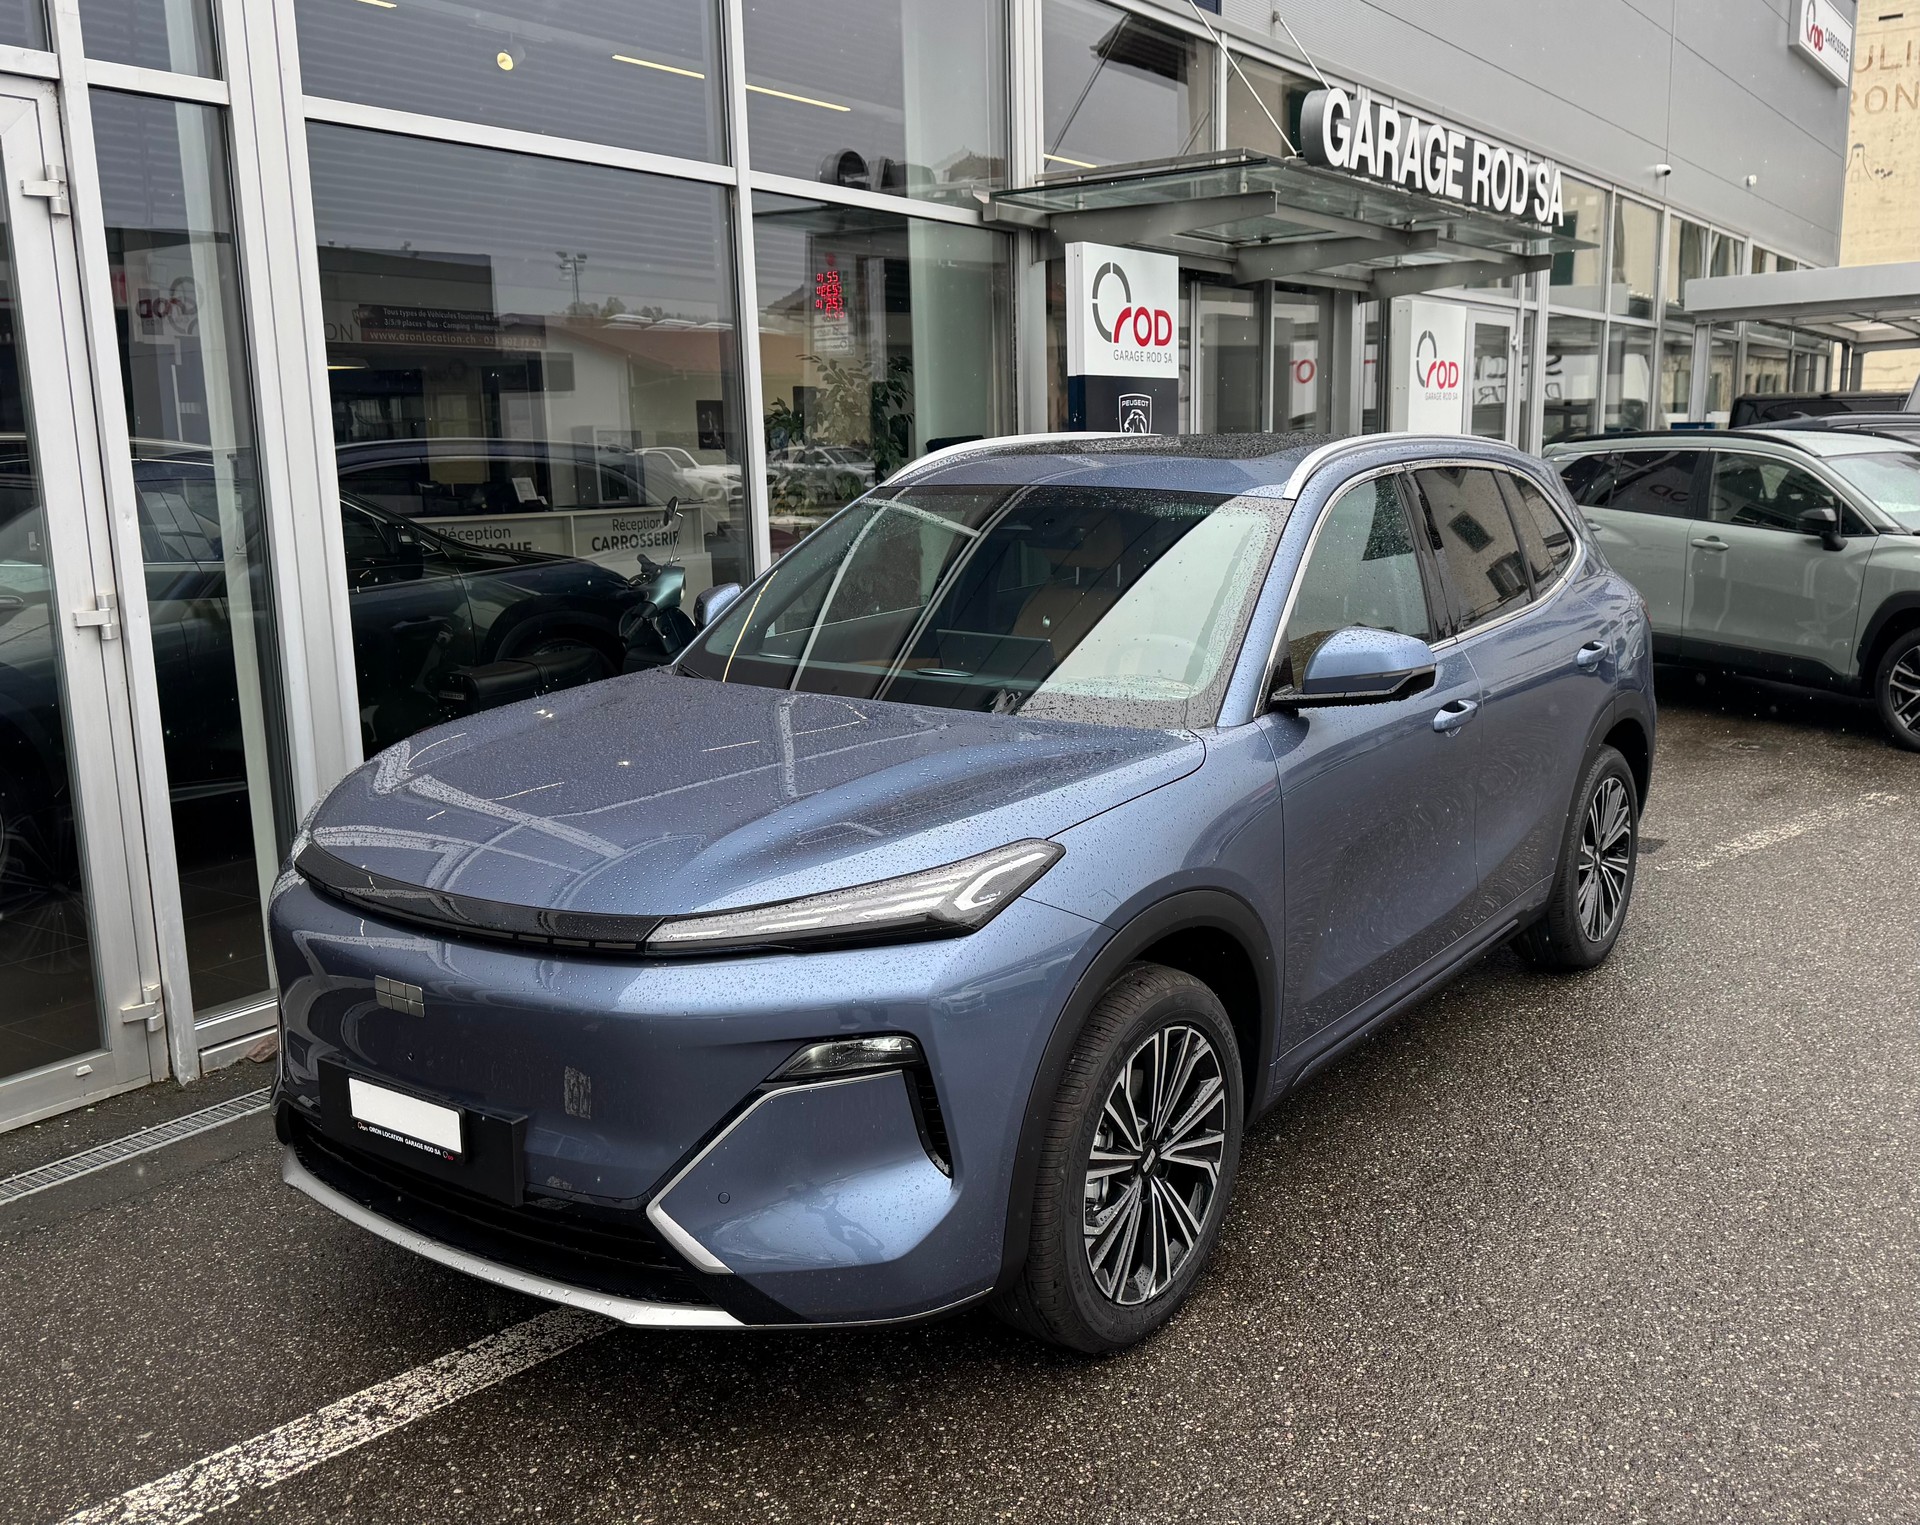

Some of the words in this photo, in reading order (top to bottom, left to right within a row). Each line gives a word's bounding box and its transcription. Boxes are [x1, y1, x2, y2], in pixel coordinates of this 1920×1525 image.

[1825, 28, 1849, 63] CARROSSERIE
[1322, 88, 1466, 199] GARAGE
[1471, 140, 1529, 216] ROD
[1534, 162, 1564, 227] SA
[384, 308, 399, 316] Tous
[400, 309, 417, 318] types
[457, 312, 485, 321] Tourisme
[402, 319, 422, 328] places
[427, 320, 439, 328] Bus
[442, 321, 471, 332] Camping
[369, 331, 476, 345] www.oronlocation.ch
[1113, 349, 1144, 362] GARAGE
[1146, 351, 1162, 363] ROD
[1164, 352, 1173, 364] SA
[1121, 399, 1149, 408] PEUGEOT
[1425, 392, 1442, 401] GARAGE
[1442, 392, 1452, 401] ROD
[1452, 392, 1458, 401] SA
[612, 517, 661, 533] Réception
[437, 525, 511, 544] Réception
[591, 531, 679, 551] CARROSSERIE
[369, 1126, 381, 1136] ORON
[382, 1131, 403, 1143] LOCATION
[405, 1138, 423, 1150] GARAGE
[424, 1144, 434, 1153] ROD
[434, 1148, 441, 1156] SA
